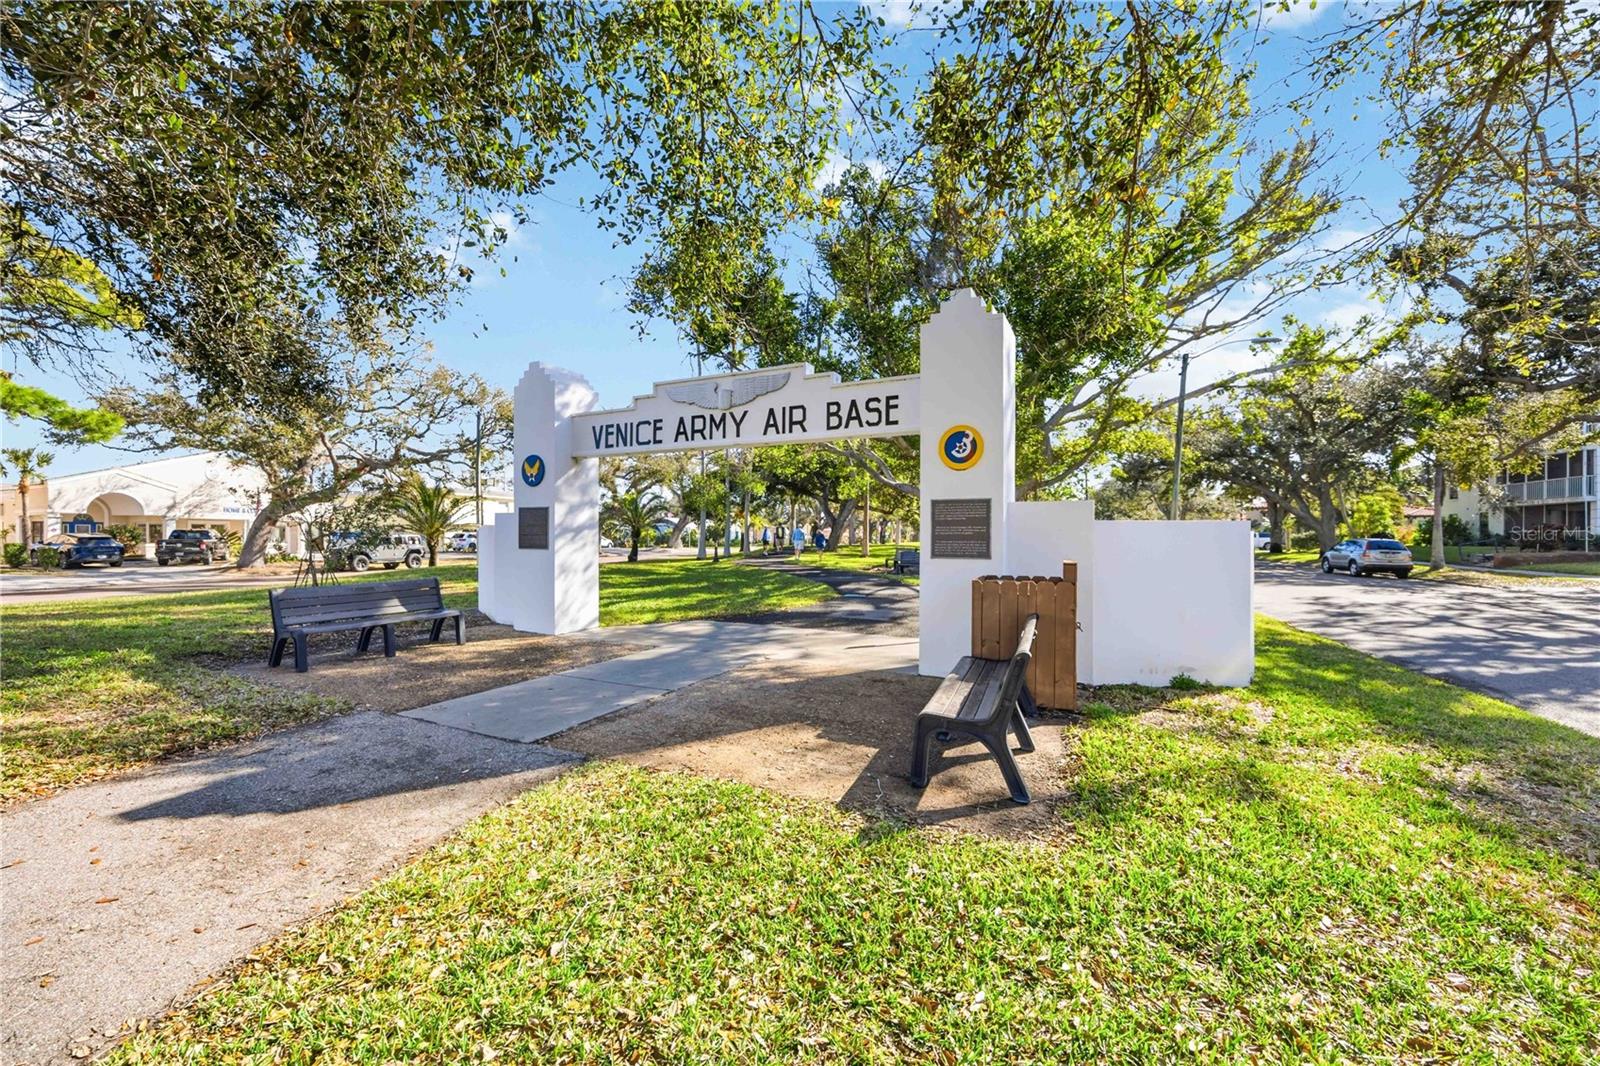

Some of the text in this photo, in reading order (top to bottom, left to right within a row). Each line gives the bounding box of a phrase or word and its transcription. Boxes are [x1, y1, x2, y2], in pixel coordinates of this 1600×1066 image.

[592, 395, 900, 450] VENICE ARMY AIR BASE
